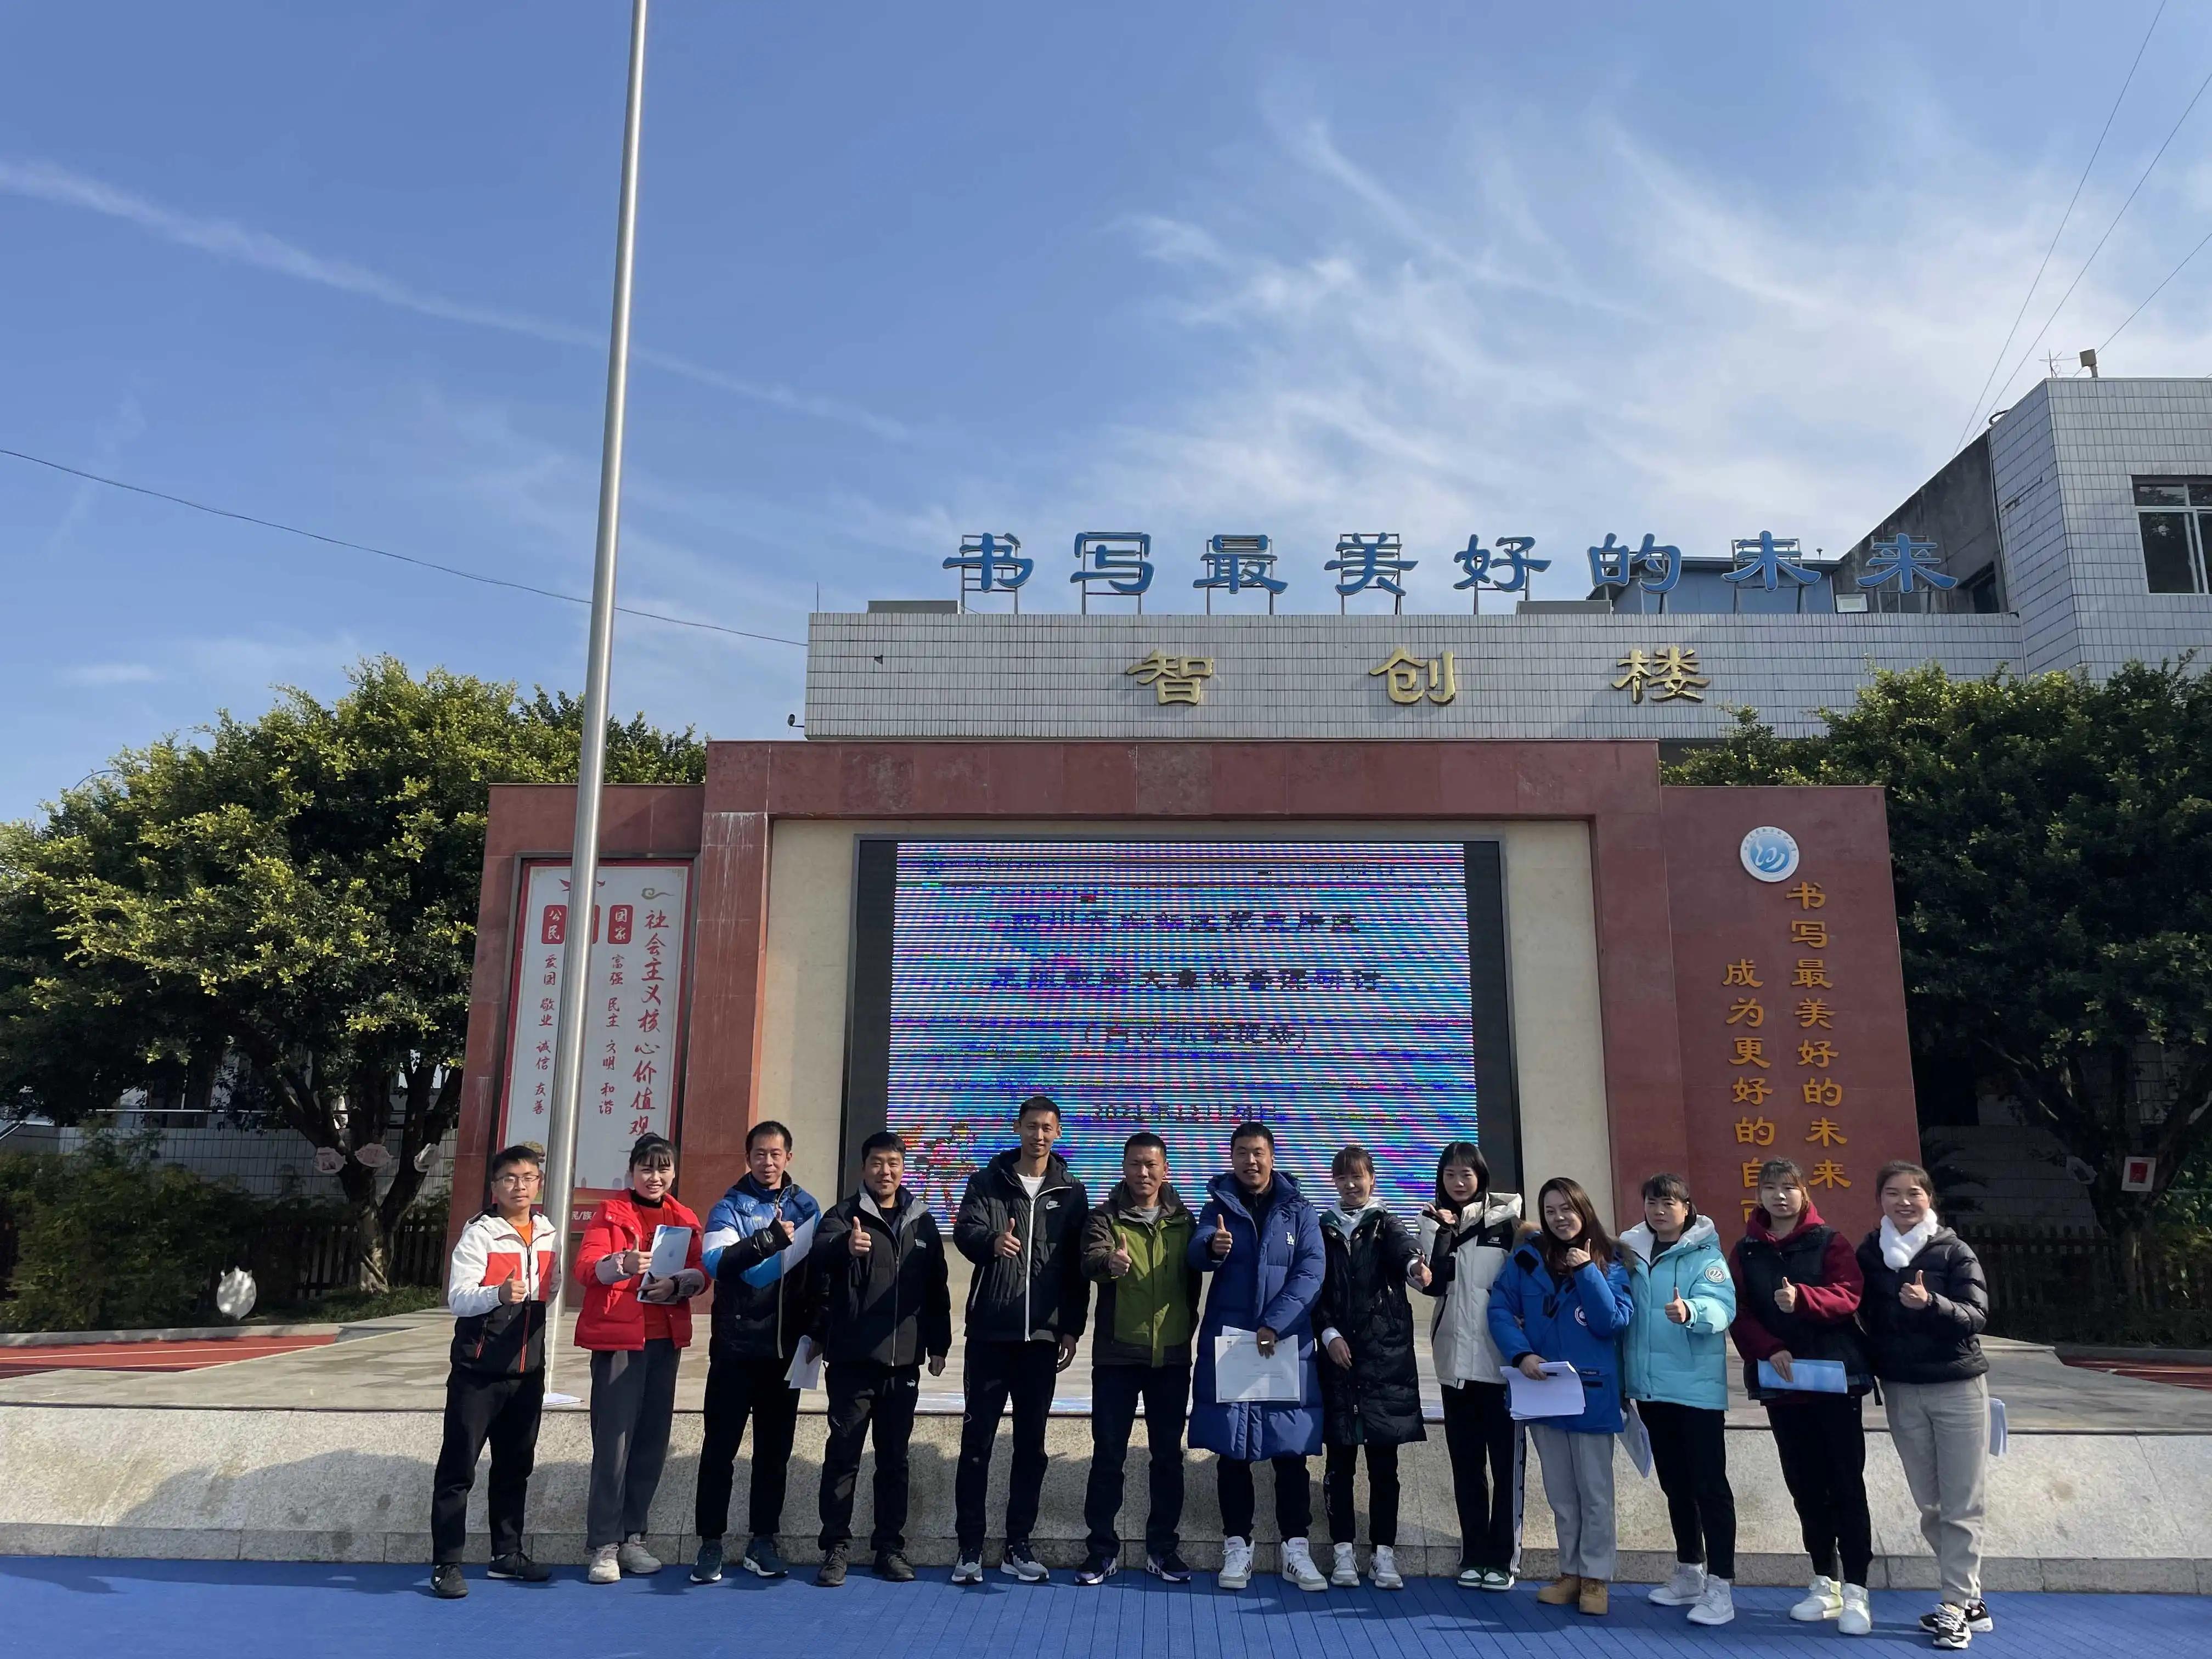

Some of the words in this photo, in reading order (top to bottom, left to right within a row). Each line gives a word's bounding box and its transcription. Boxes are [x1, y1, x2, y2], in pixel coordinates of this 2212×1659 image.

[942, 530, 1958, 595] 书写最美好的未来
[1127, 646, 1711, 704] 智创楼
[548, 908, 562, 940] 公民
[615, 908, 628, 940] 国家
[543, 953, 557, 986] 爱国
[609, 954, 624, 985] 富强
[538, 997, 554, 1028] 敬业
[606, 997, 620, 1028] 民主
[628, 909, 669, 1136] 社会主义核心价值观
[1786, 882, 1851, 1189] 书写最美好的未来
[535, 1040, 551, 1070] 诚信
[602, 1040, 617, 1070] 文明
[532, 1082, 546, 1115] 友善
[599, 1082, 615, 1115] 和谐
[1723, 958, 1775, 1224] 成为更好的自
